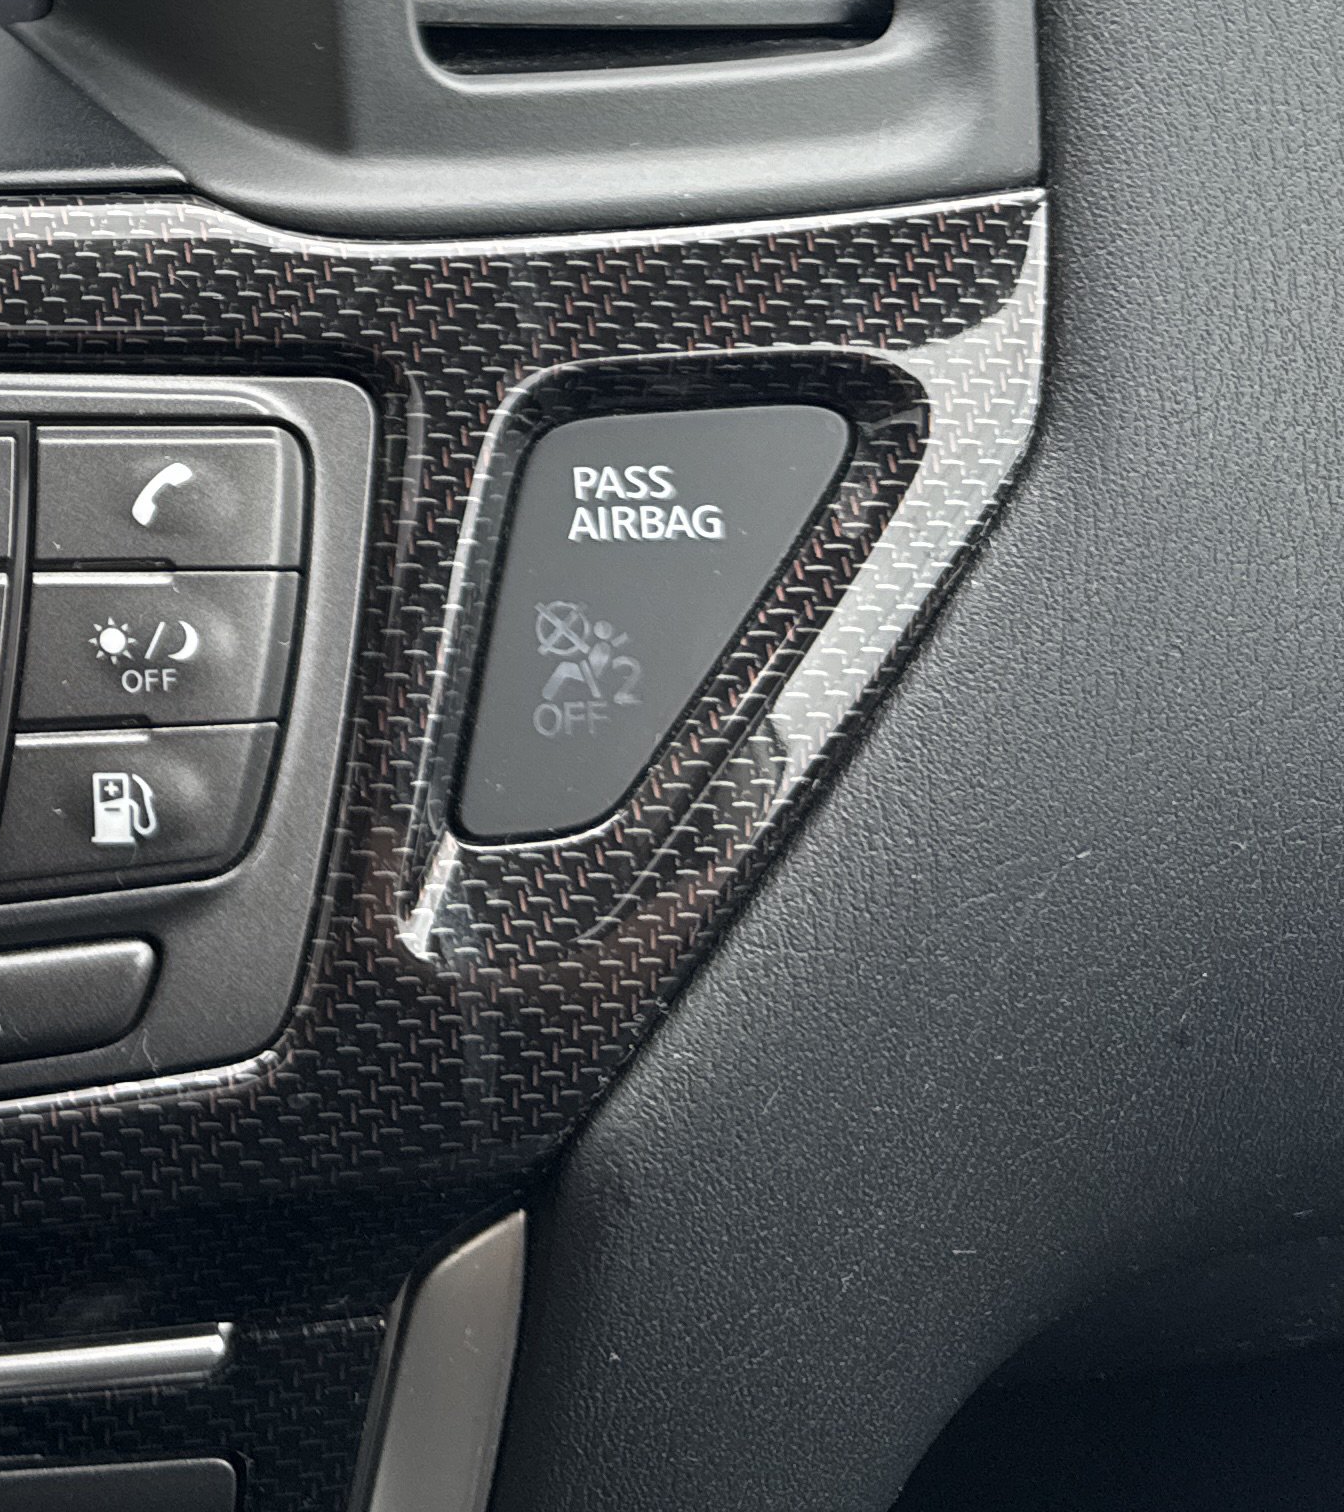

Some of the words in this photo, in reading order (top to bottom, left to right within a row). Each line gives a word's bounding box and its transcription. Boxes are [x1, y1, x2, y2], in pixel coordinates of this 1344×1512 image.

[572, 465, 676, 500] PASS
[568, 504, 726, 541] AIRBAG
[121, 668, 179, 693] OFF
[532, 700, 610, 739] OFF
